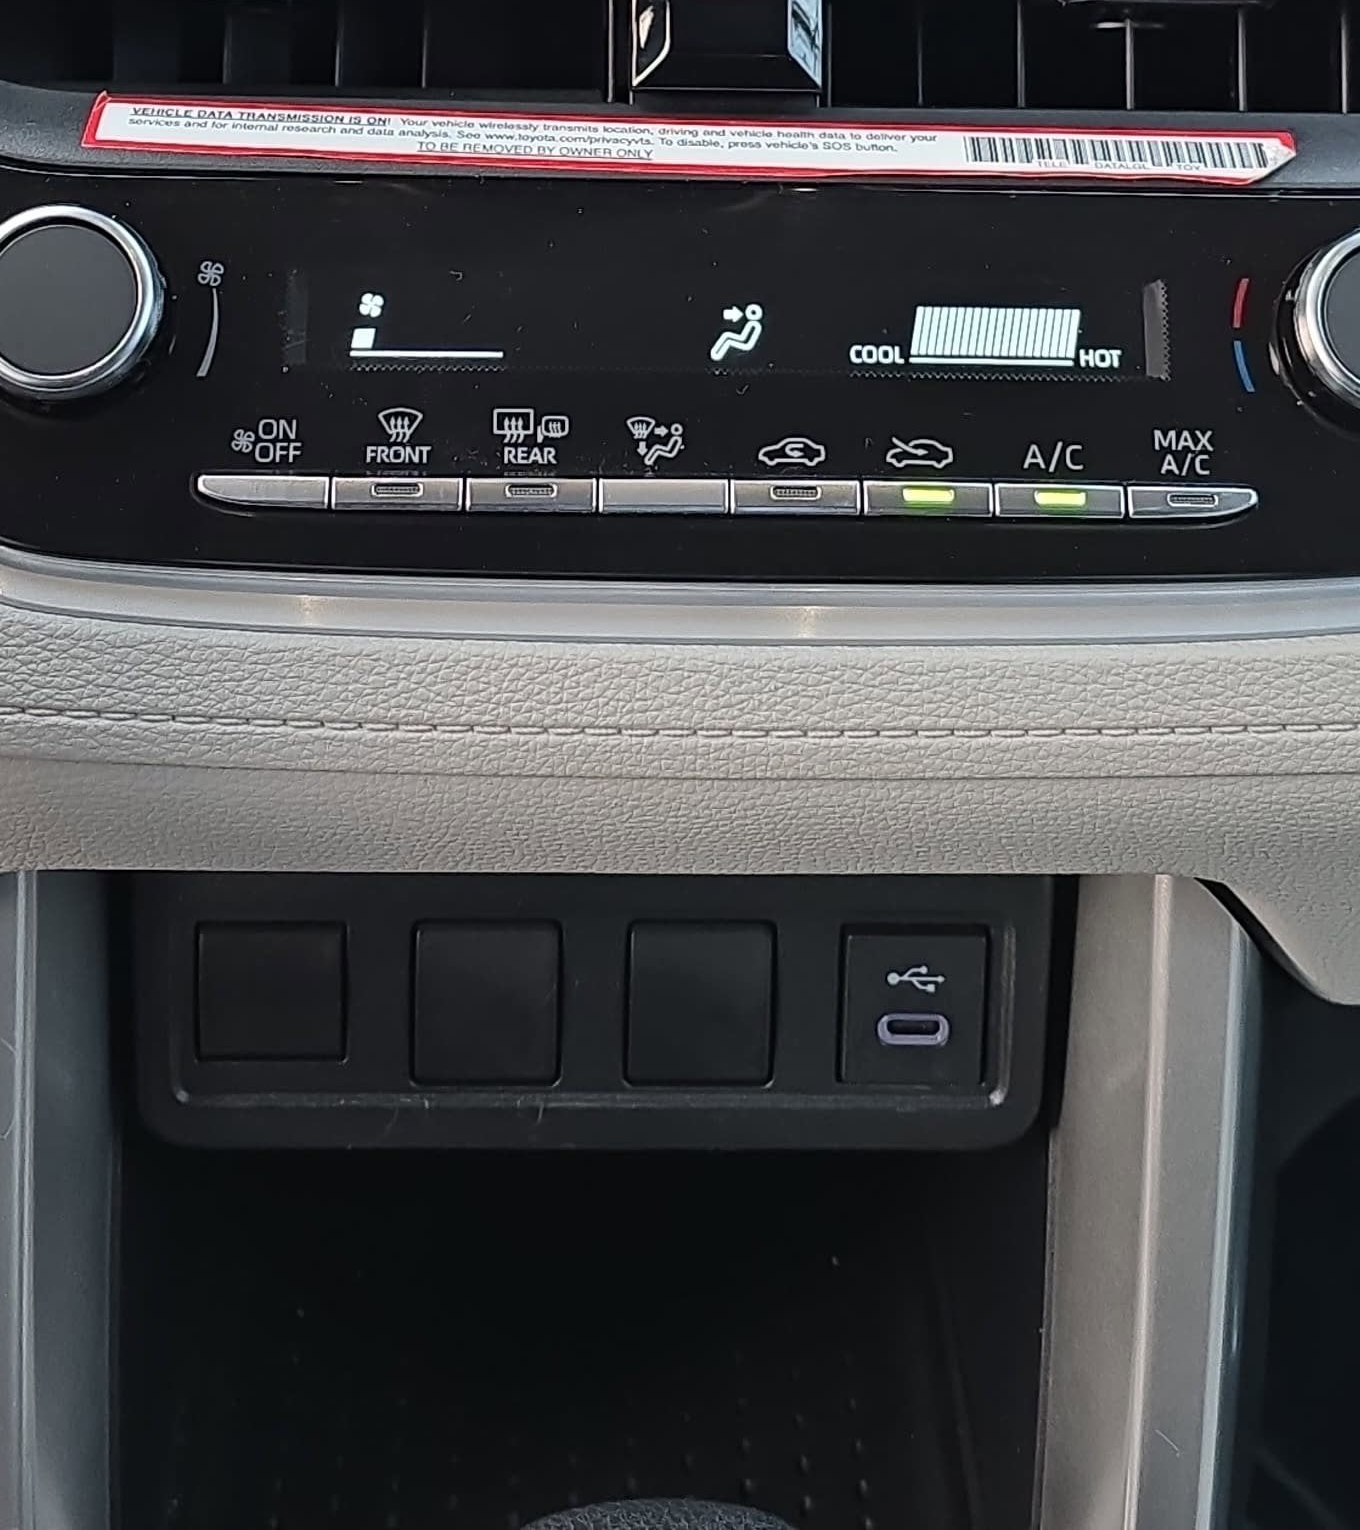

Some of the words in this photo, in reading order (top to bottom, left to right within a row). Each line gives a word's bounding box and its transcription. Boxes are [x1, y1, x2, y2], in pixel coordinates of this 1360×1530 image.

[128, 117, 180, 127] services
[184, 119, 209, 128] and
[212, 120, 228, 129] for
[231, 121, 282, 132] internal
[285, 124, 337, 134] research
[341, 126, 364, 135] and
[367, 127, 395, 136] data
[398, 129, 452, 141] analysis.
[457, 130, 481, 139] See
[659, 136, 673, 145] To
[676, 137, 723, 149] disable,
[726, 141, 762, 151] press
[766, 140, 819, 150] vehicle's
[823, 141, 852, 151] SOS
[855, 142, 898, 152] button.
[132, 107, 192, 118] VEHICLE
[197, 109, 233, 120] DATA
[239, 111, 344, 125] TRANSMISSION
[349, 115, 362, 125] IS
[366, 116, 391, 127] ON!
[399, 117, 428, 128] Your
[433, 118, 476, 129] vehicle
[479, 120, 539, 133] wirelessly
[542, 123, 597, 134] transmits
[602, 125, 655, 135] location,
[658, 127, 700, 139] driving
[703, 129, 726, 138] and
[730, 129, 773, 139] vehicle
[776, 130, 814, 140] health
[818, 130, 846, 140] data
[850, 132, 862, 141] to
[866, 132, 905, 142] deliver
[909, 134, 937, 145] your
[418, 141, 435, 152] TO
[439, 142, 459, 153] BE
[463, 143, 534, 156] REMOVED
[538, 145, 555, 156] BY
[558, 147, 613, 158] OWNER
[616, 149, 654, 160] ONLY
[850, 345, 904, 365] COOL
[1079, 348, 1121, 369] HOT
[258, 420, 297, 440] ON
[1154, 430, 1214, 451] MAX
[255, 442, 301, 464] OFF
[366, 446, 431, 464] FRONT
[503, 446, 557, 464] REAR
[1024, 442, 1084, 472] A/C
[1160, 451, 1211, 475] A/C
